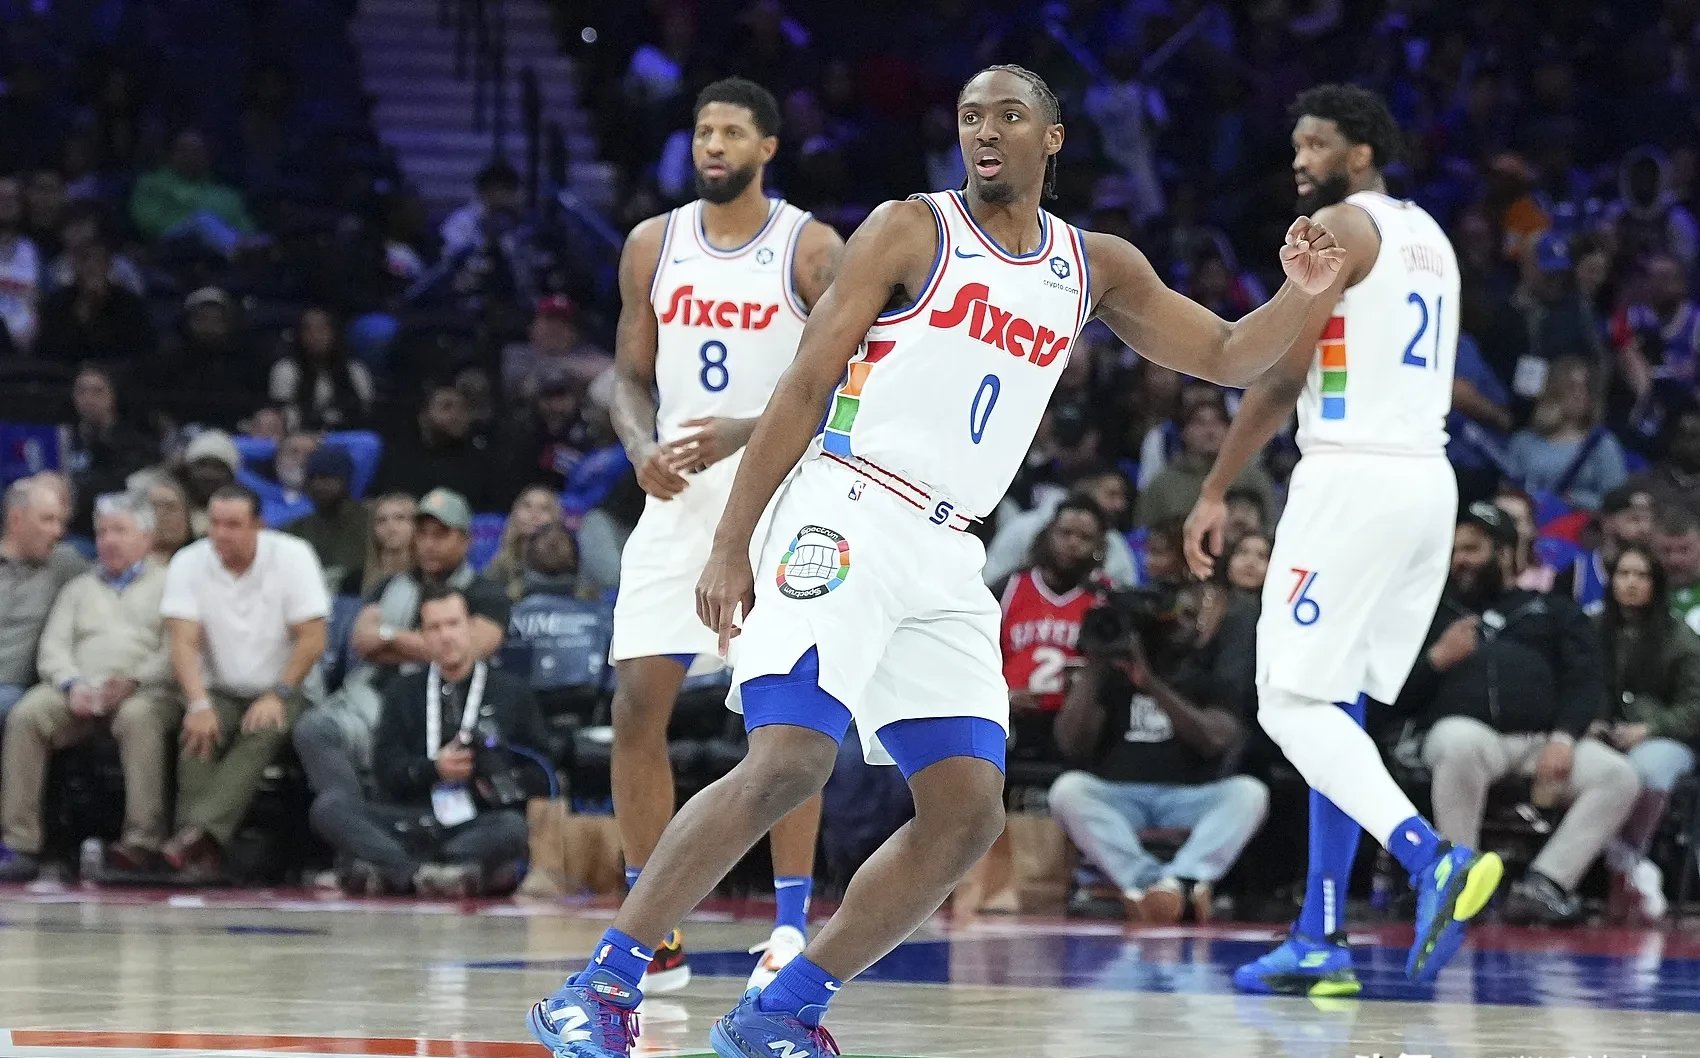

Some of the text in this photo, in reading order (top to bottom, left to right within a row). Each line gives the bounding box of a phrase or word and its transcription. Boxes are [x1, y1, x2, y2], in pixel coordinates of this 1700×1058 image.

[660, 285, 779, 331] Sixers
[1043, 279, 1079, 296] crypto.com
[928, 282, 1070, 368] Sixers
[1402, 292, 1443, 371] 21
[700, 339, 730, 393] 8
[969, 373, 1001, 445] 0
[800, 526, 840, 541] Spectrum
[783, 586, 823, 599] Spectrum
[1286, 566, 1321, 627] 76
